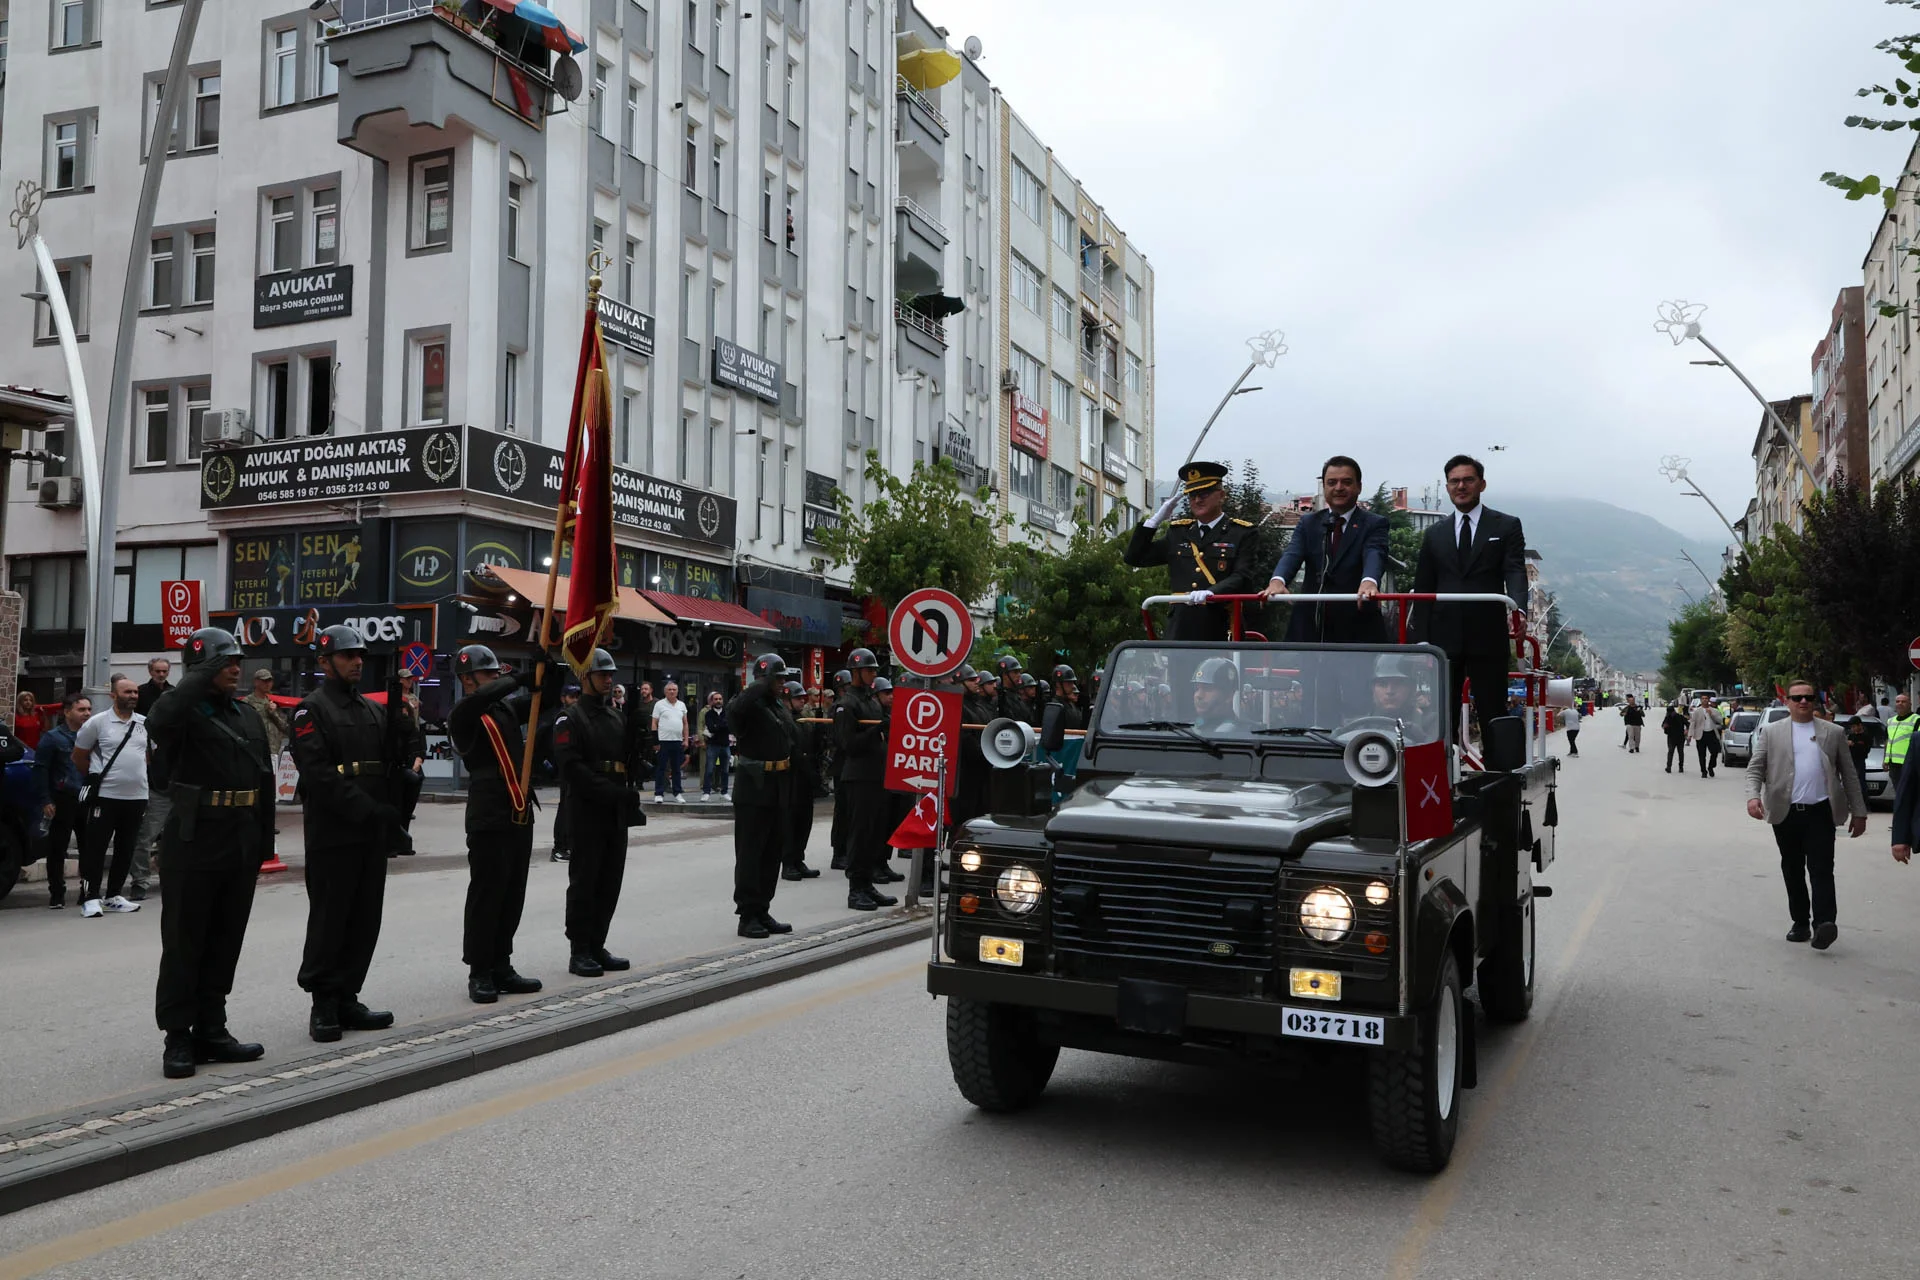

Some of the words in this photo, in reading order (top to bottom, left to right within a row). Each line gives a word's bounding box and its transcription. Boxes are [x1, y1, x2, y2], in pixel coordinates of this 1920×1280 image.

[268, 272, 336, 297] AVUKAT
[260, 304, 281, 313] Büşra
[282, 299, 308, 309] SONSA
[310, 293, 344, 306] ÇORMAN
[598, 299, 647, 331] AVUKAT
[740, 352, 776, 379] AVUKAT
[720, 368, 738, 383] HUKUK
[739, 376, 745, 386] VE
[245, 448, 301, 468] AVUKAT
[304, 441, 354, 462] DOĞAN
[358, 438, 407, 456] AKTAŞ
[240, 470, 288, 487] HUKUK
[297, 468, 307, 482] &
[311, 458, 411, 480] DANIŞMANLIK
[258, 491, 278, 501] 0546
[279, 489, 295, 499] 585
[297, 488, 307, 497] 19
[308, 487, 319, 496] 67
[325, 484, 346, 495] 0356
[348, 483, 364, 493] 212
[366, 481, 377, 491] 43
[378, 480, 390, 490] 00
[612, 472, 645, 493] OĞAN
[647, 482, 682, 505] AKTAŞ
[622, 513, 639, 524] 0356
[640, 517, 652, 527] 212
[653, 521, 662, 530] 43
[663, 523, 671, 531] 00
[235, 541, 270, 562] SEN
[302, 535, 339, 556] SEN
[622, 551, 635, 560] SEN
[664, 560, 677, 569] SEN
[302, 568, 327, 579] YETER
[687, 565, 710, 582] SEN
[235, 579, 258, 589] YETER
[300, 581, 338, 598] İSTE!
[175, 589, 186, 607] P
[233, 590, 268, 608] İSTE!
[171, 614, 191, 624] OTO
[169, 626, 194, 636] PARK
[917, 701, 936, 725] P
[902, 734, 942, 753] OTO
[894, 752, 949, 775] PARK
[1287, 1013, 1380, 1040] 037718
